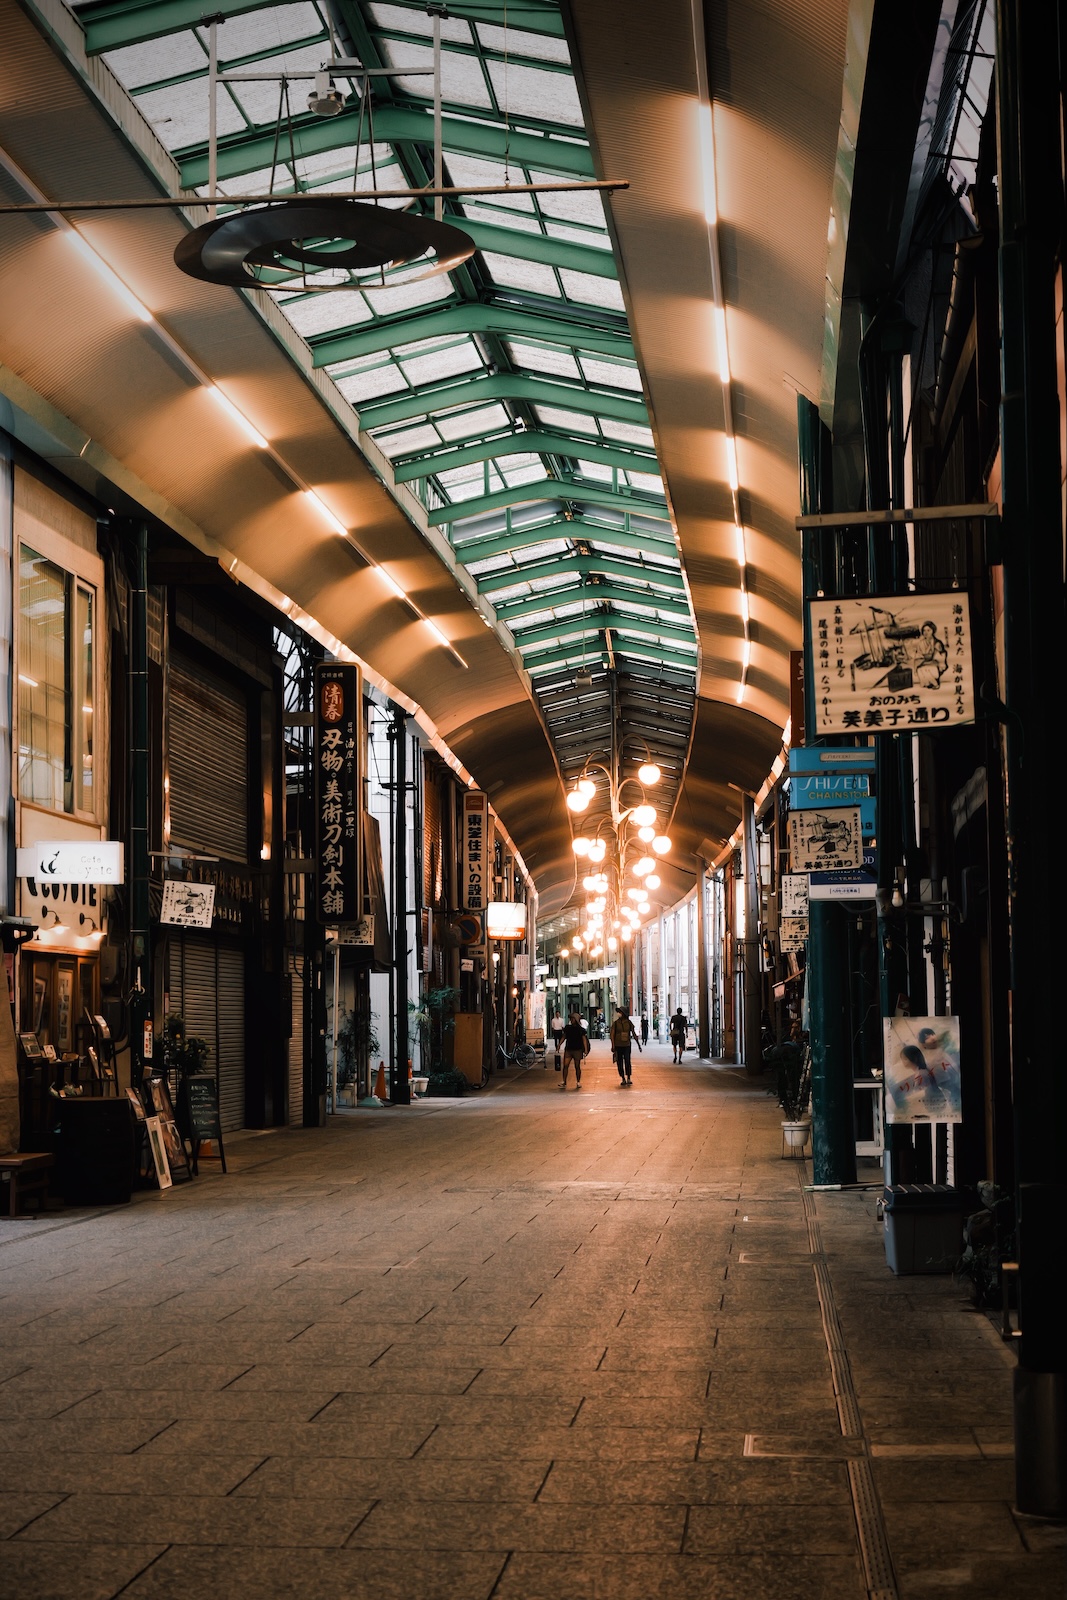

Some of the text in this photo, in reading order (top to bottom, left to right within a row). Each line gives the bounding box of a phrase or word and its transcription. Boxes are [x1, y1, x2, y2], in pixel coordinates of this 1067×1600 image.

[833, 605, 846, 678] 五年振りに 見る
[952, 604, 966, 715] 海が見えた 海が見える
[817, 619, 833, 726] 尾道の海は なつかしい
[324, 684, 342, 721] 清春
[869, 694, 922, 707] おのみち
[799, 775, 870, 791] SHISEID
[467, 814, 482, 908] 東芝住まいの設備
[899, 1060, 951, 1092] リライト
